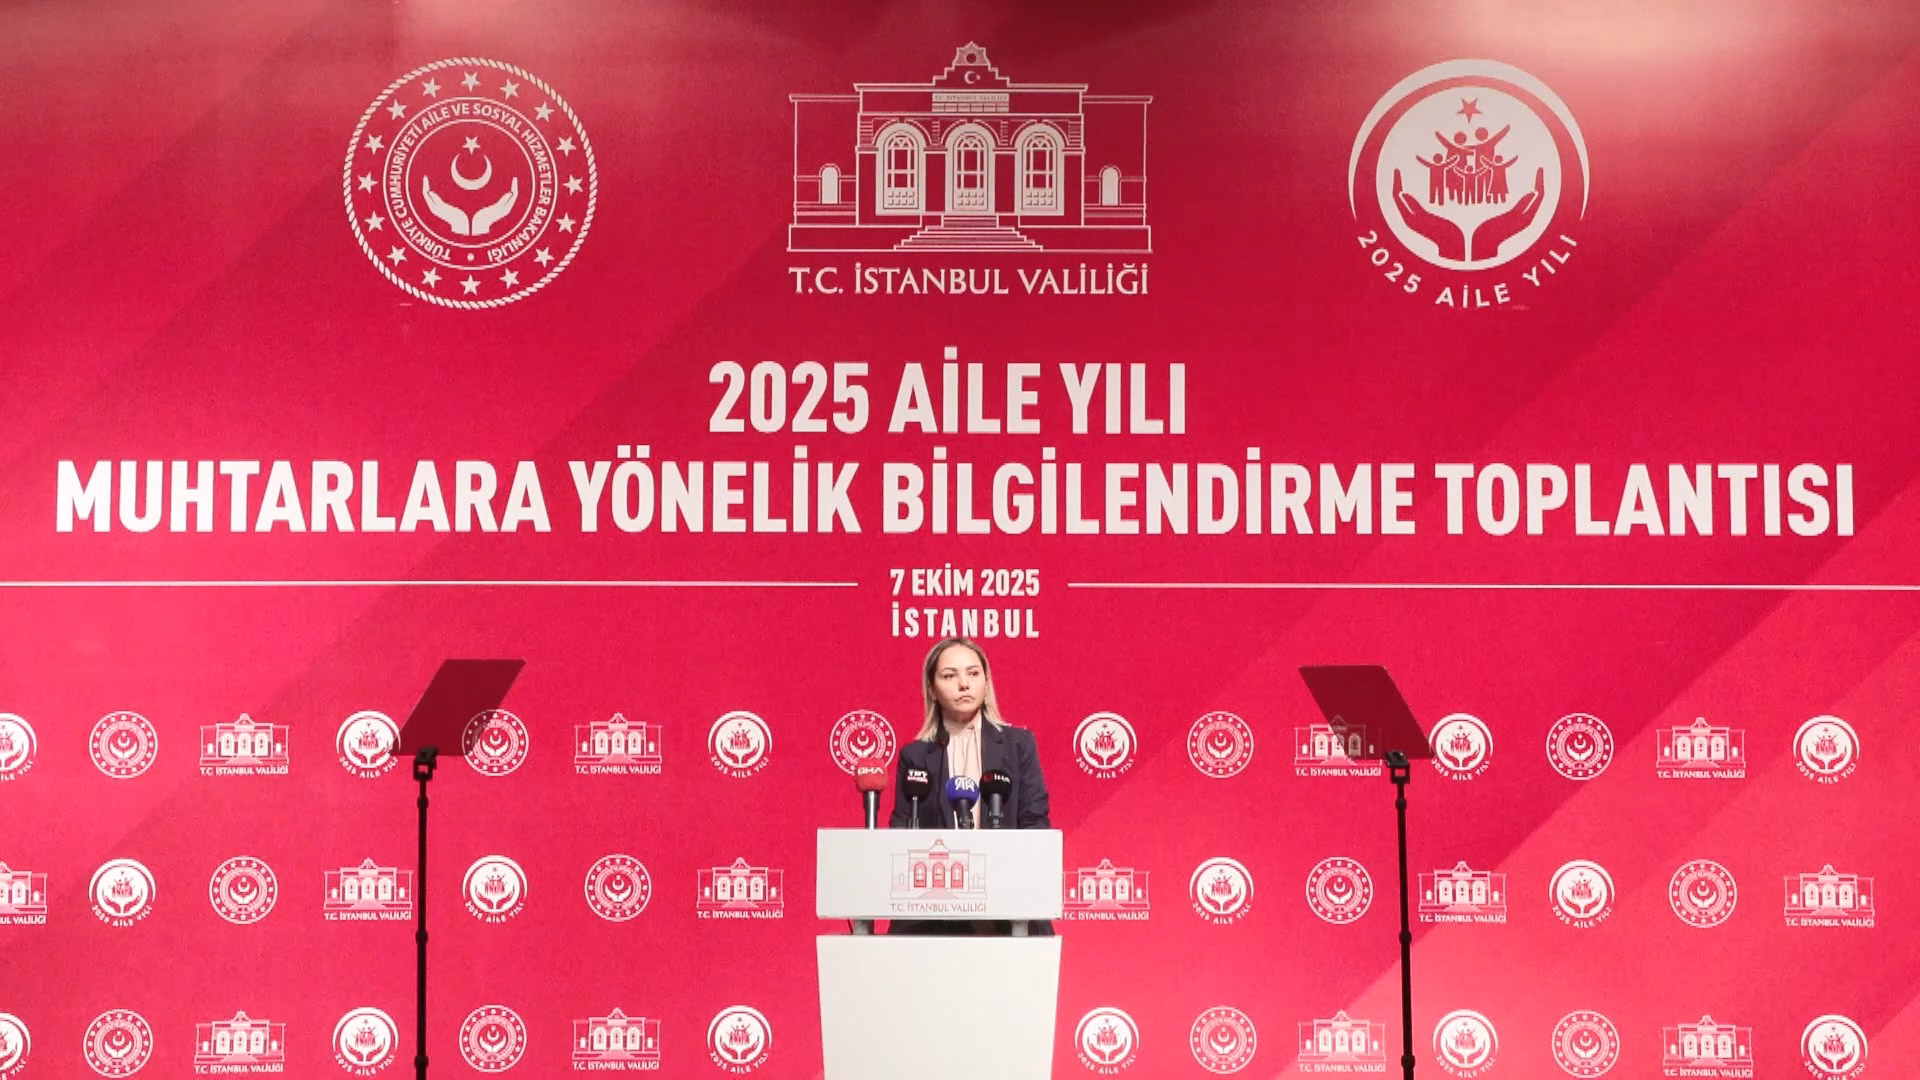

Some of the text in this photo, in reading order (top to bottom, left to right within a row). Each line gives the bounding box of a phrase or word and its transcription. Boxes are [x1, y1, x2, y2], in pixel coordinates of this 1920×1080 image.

[389, 103, 553, 262] TÜRKİYE CUMHURİYETİ AİLE VE SOSYAL HİZMETLER BAKANLIĞI
[789, 262, 1149, 295] T.C. İSTANBUL VALİLİĞİ
[1357, 230, 1577, 308] 2025 AİLE YILI
[710, 347, 1185, 435] 2025 AİLE YILI
[56, 445, 1854, 537] MUHTARLARA YÖNELİK BİLGİLENDİRME TOPLANTISI
[890, 563, 1040, 597] 7 EKİM 2025
[892, 602, 1040, 638] İSTANBUL
[908, 901, 948, 913] İSTANBUL
